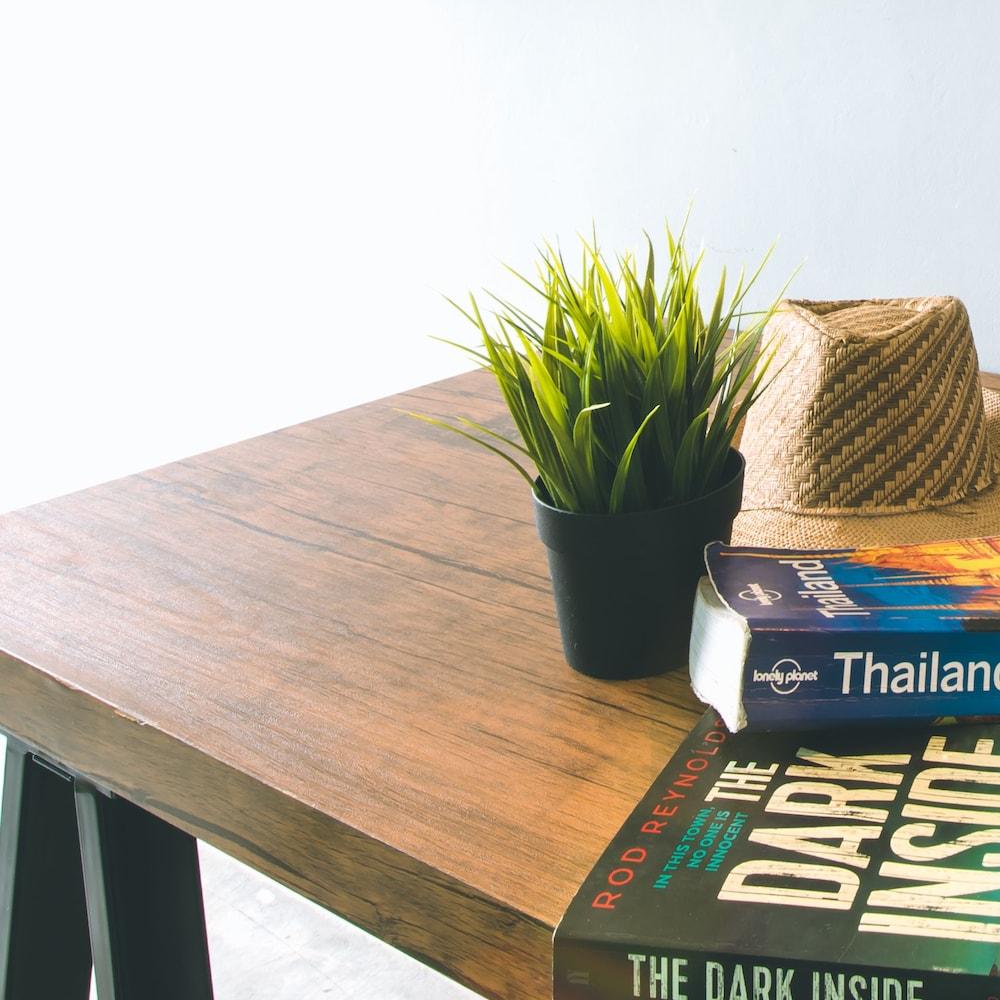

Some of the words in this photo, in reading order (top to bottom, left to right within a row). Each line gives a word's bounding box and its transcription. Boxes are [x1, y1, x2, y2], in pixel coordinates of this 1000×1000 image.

[778, 559, 871, 618] Thailand
[753, 670, 785, 686] lonely
[785, 670, 818, 685] planet
[704, 759, 781, 802] THE
[687, 846, 706, 869] NO
[698, 818, 725, 853] ONE
[717, 810, 731, 824] IS
[704, 811, 750, 873] INNOCENT
[717, 747, 911, 911] DARK
[592, 847, 647, 911] ROD
[652, 871, 673, 889] IN
[664, 840, 690, 876] THIS
[628, 954, 688, 1000] THE
[705, 961, 796, 1000] DARK
